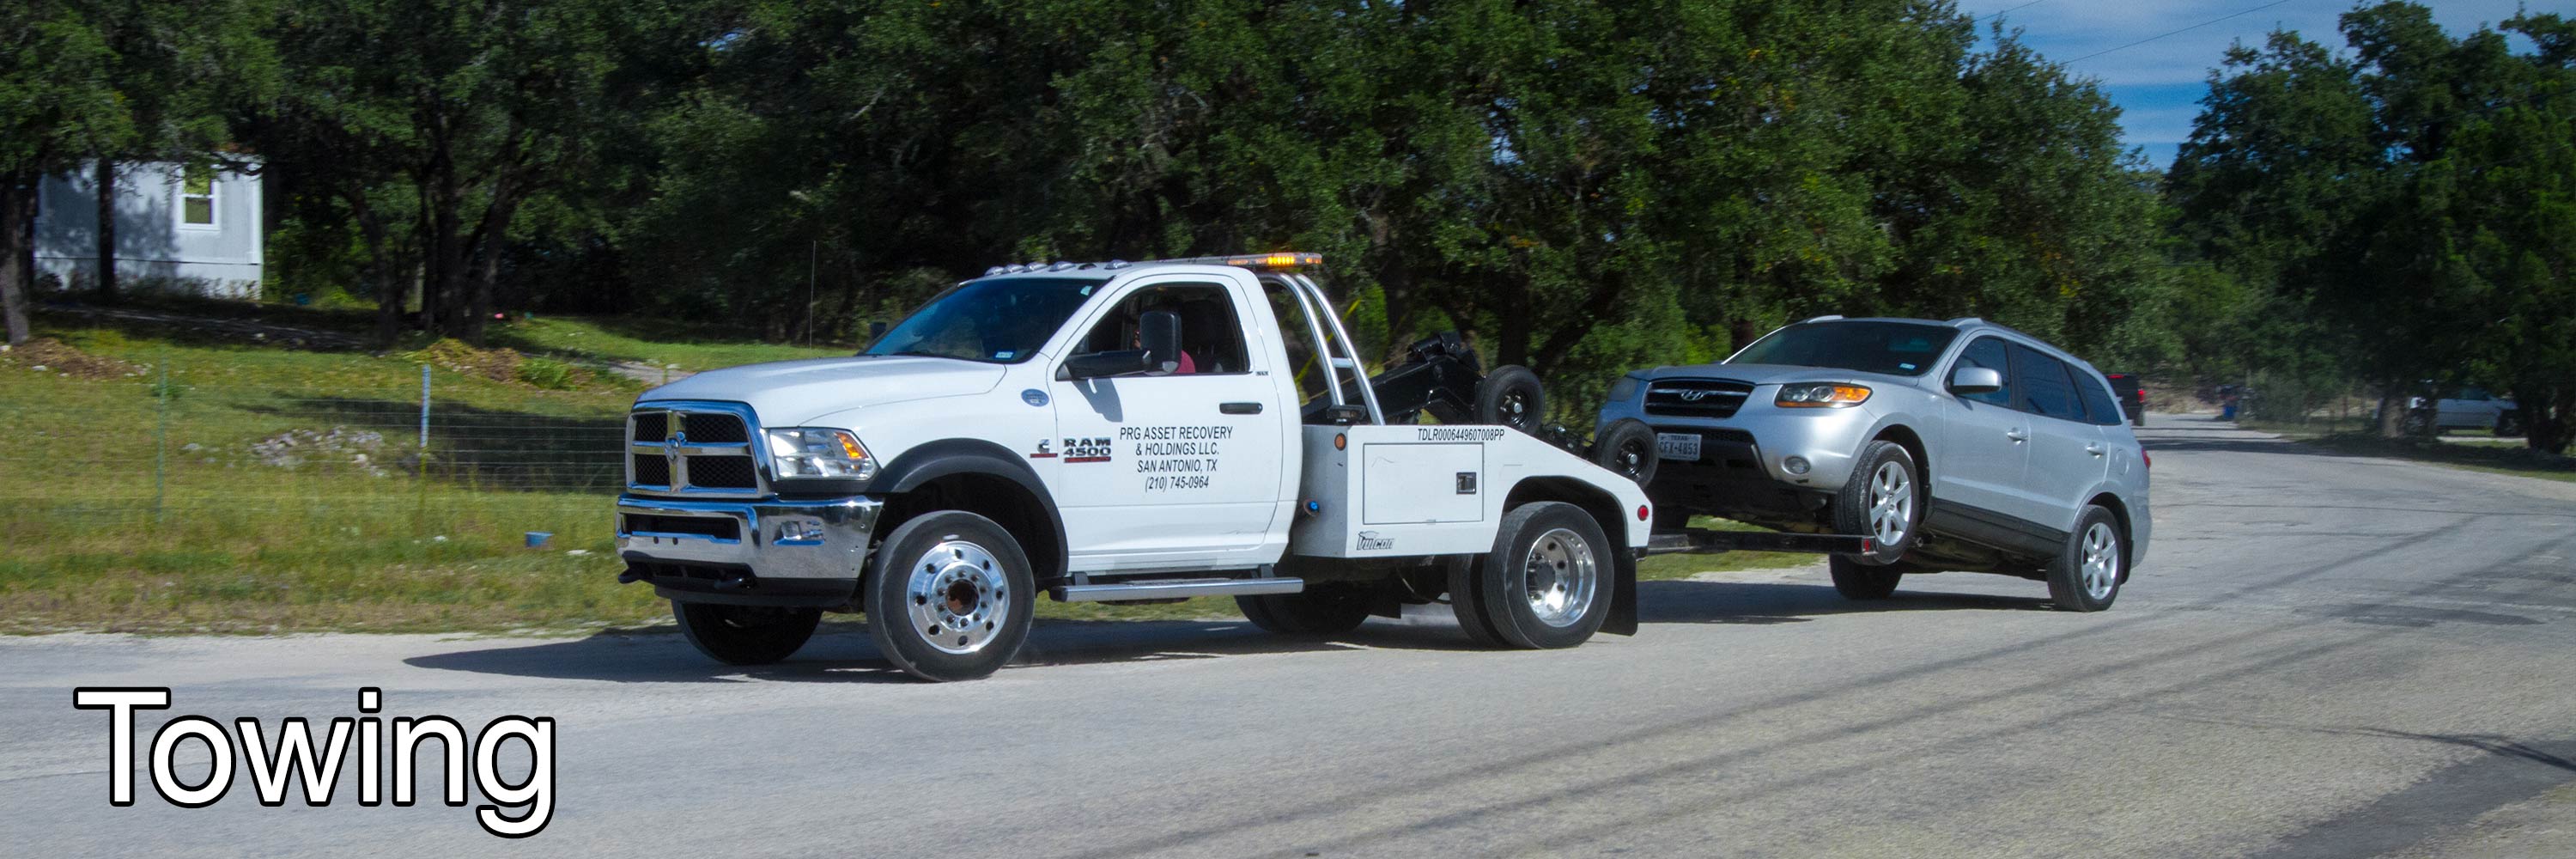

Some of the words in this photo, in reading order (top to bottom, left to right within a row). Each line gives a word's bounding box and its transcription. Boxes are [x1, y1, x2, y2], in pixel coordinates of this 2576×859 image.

[1120, 427, 1141, 440] PRG
[1144, 426, 1176, 440] ASSET
[1179, 426, 1233, 439] RECOVERY
[1064, 438, 1111, 447] RAM
[1136, 442, 1142, 455] &
[1145, 442, 1196, 455] HOLDINGS
[1199, 442, 1219, 455] LLC.
[1064, 447, 1111, 456] 4500
[1138, 460, 1157, 472] SAN
[1158, 459, 1203, 474] ANTONIO,
[1206, 459, 1218, 472] TX
[1145, 476, 1167, 492] (210)
[1170, 475, 1209, 489] 745-0964
